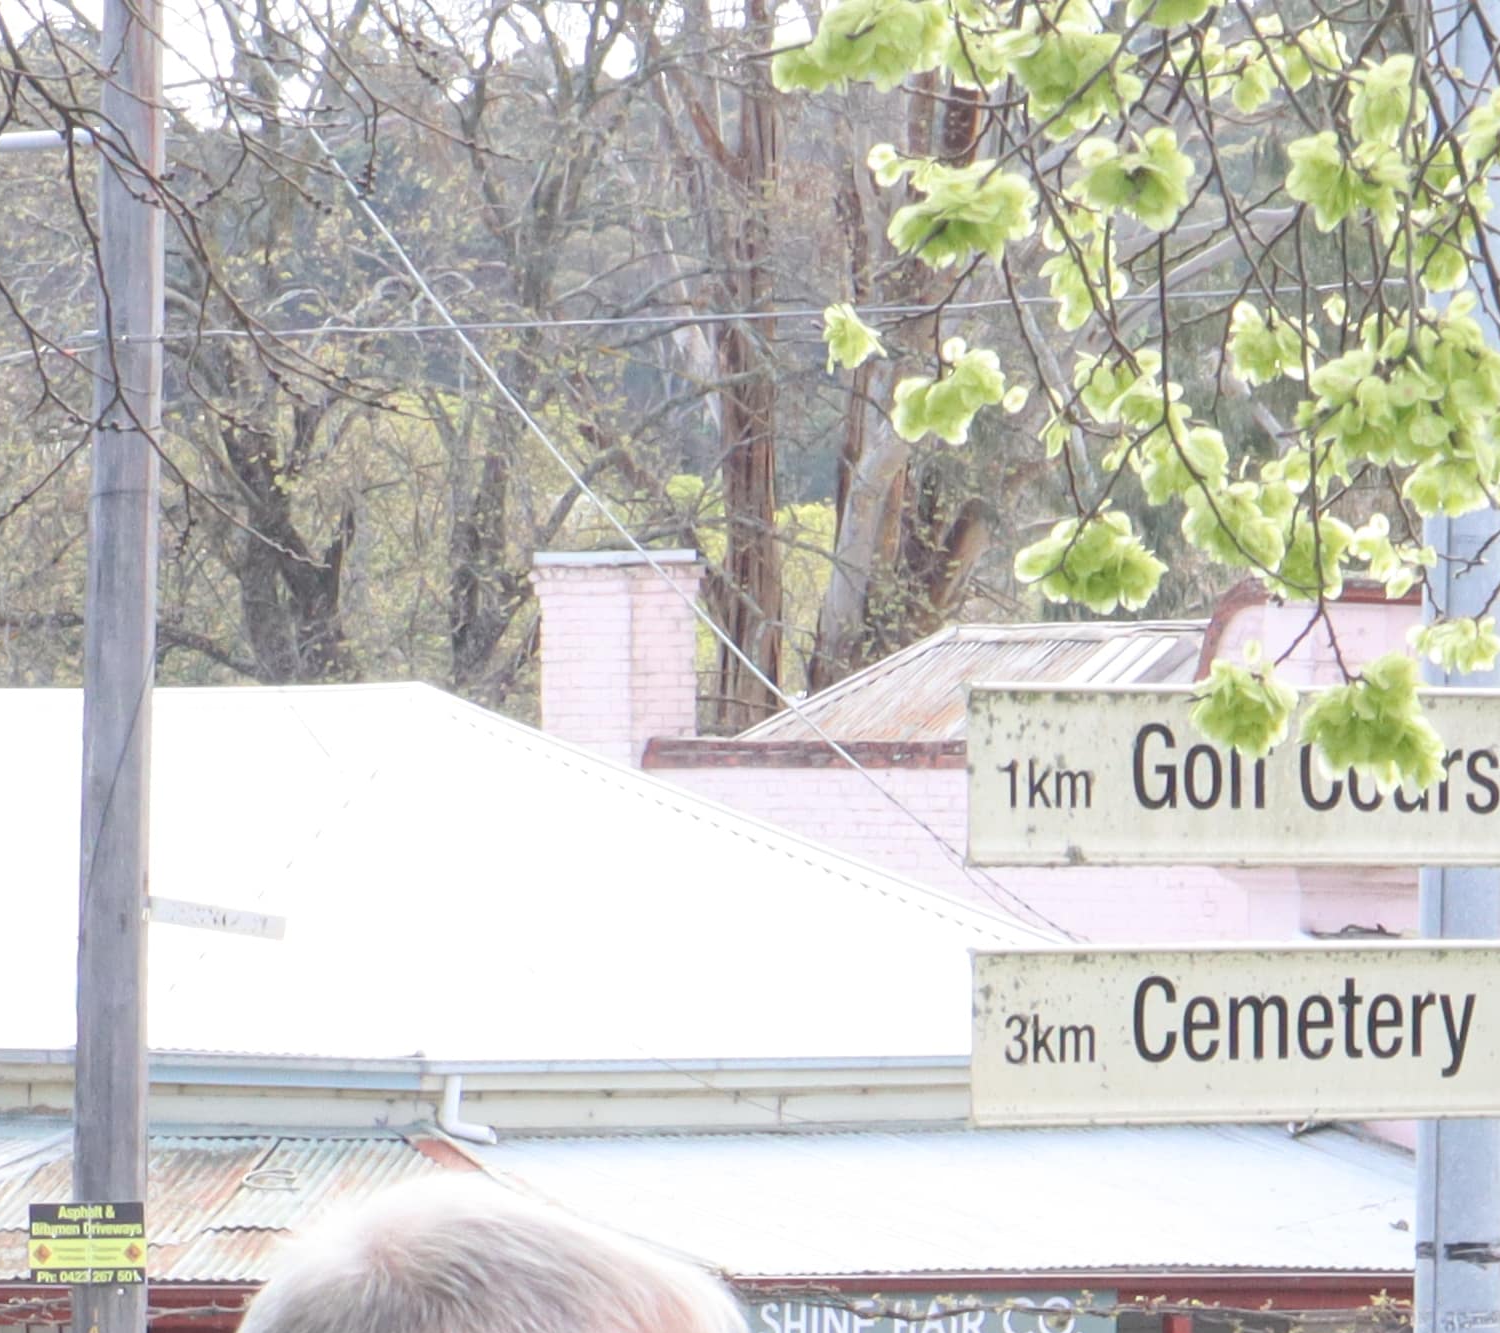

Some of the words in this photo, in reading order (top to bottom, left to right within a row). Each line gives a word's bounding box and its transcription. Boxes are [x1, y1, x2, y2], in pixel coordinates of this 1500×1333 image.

[1003, 759, 1092, 811] 1km
[1003, 1013, 1096, 1065] 3km
[1132, 975, 1478, 1078] Cemetery
